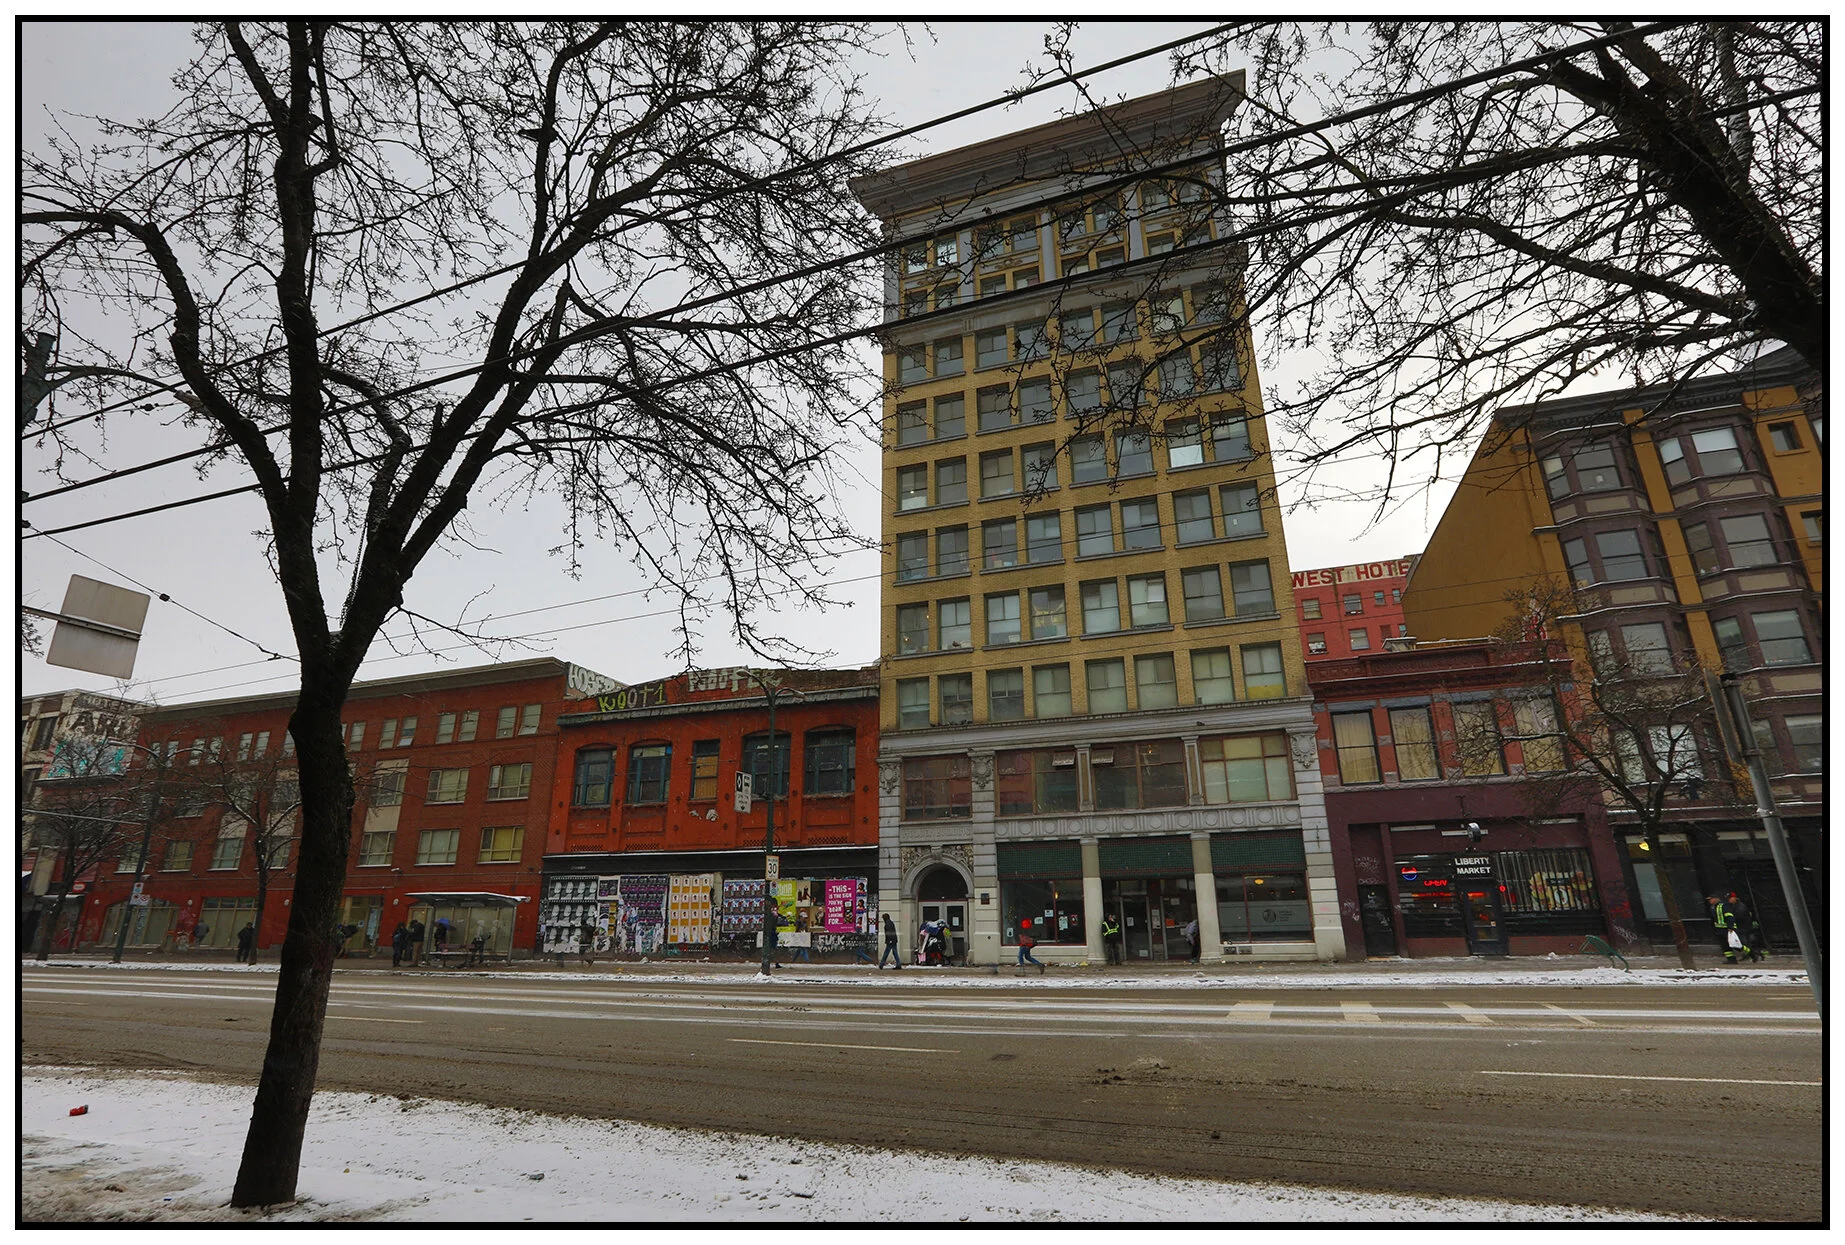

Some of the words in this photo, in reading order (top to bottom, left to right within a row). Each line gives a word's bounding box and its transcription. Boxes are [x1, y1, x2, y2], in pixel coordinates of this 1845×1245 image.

[1291, 567, 1345, 588] WEST
[1454, 857, 1489, 866] LIBERTY
[768, 863, 777, 874] 30
[1456, 866, 1491, 875] MARKET
